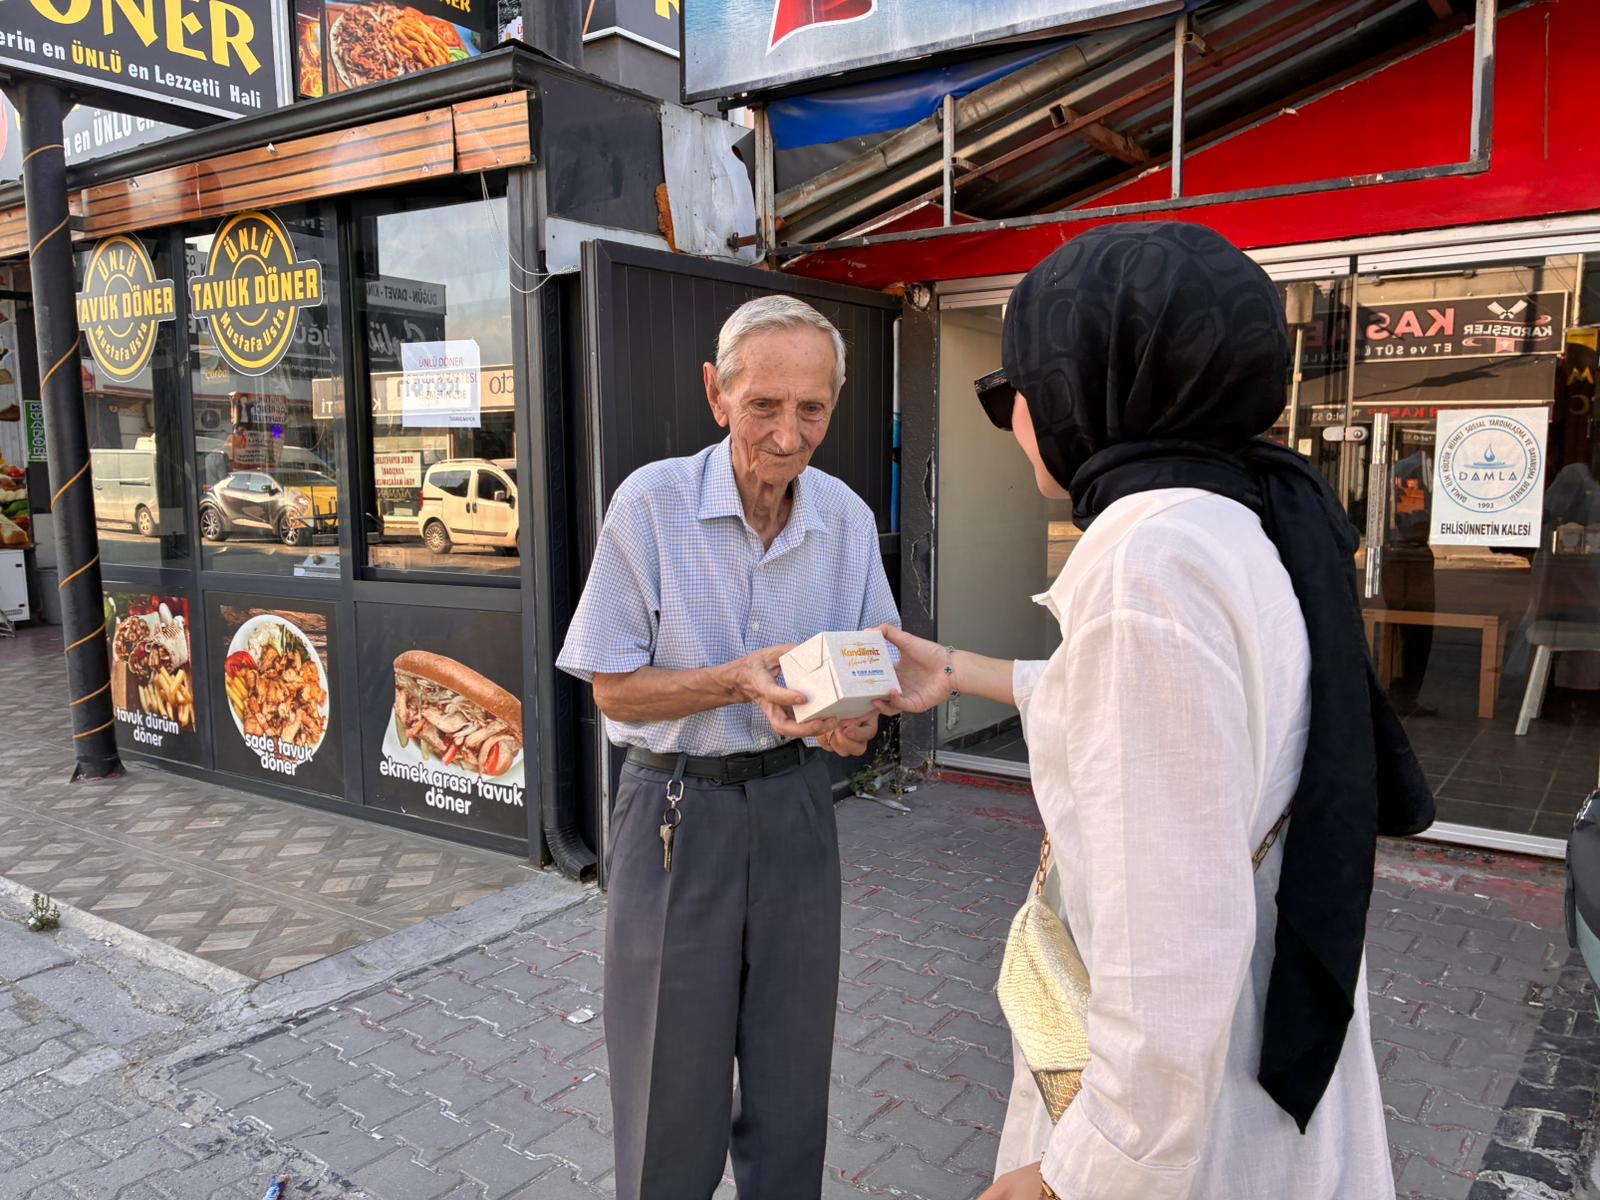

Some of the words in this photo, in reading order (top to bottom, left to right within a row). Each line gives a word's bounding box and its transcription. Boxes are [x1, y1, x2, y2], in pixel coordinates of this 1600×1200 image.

[42, 42, 66, 60] en
[71, 40, 122, 74] ÜNLÜ
[128, 63, 149, 80] en
[154, 65, 220, 98] Lezzetli
[229, 84, 261, 109] Hali
[74, 130, 91, 153] en
[223, 226, 274, 263] ÜNLÜ
[97, 249, 137, 282] ÜNLÜ
[122, 284, 174, 318] DÖNER
[192, 277, 250, 311] TAVUK
[254, 266, 318, 305] DÖNER
[95, 325, 130, 361] Mustafa
[129, 322, 148, 355] Usta
[220, 311, 263, 352] Mustafa
[262, 309, 285, 346] Usta
[1465, 420, 1486, 433] SOSYAL
[1459, 471, 1517, 481] DAMLA
[1440, 521, 1501, 535] EHLİSÜNNETİN
[1501, 521, 1531, 536] KALESİ
[116, 705, 143, 726] tavuk
[145, 713, 179, 735] dürüm
[133, 726, 163, 747] döner
[245, 732, 274, 751] sade
[277, 738, 313, 762] tavuk
[260, 752, 298, 776] döner
[379, 756, 428, 785] ekmek
[432, 770, 472, 794] arası
[476, 777, 524, 807] tavuk
[425, 787, 472, 815] döner
